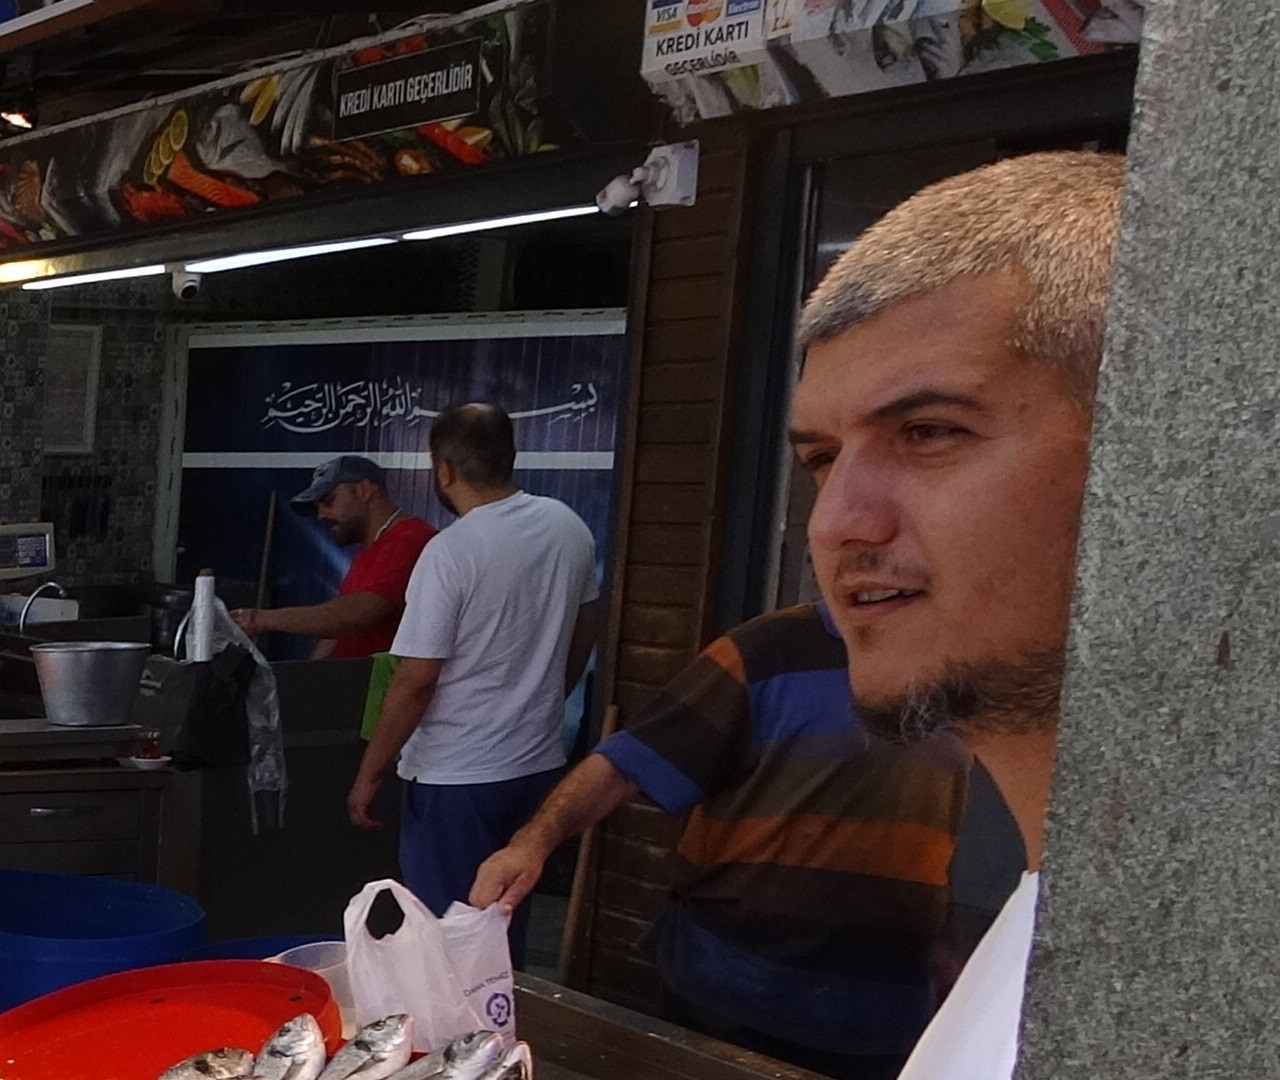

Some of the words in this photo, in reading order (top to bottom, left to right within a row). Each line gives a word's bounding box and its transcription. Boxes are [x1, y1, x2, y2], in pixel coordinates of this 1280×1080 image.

[656, 7, 679, 23] VISA
[656, 28, 701, 57] KREDİ
[703, 20, 749, 47] KARTI
[340, 83, 372, 117] KREDİ
[372, 79, 405, 110] KARTI
[406, 61, 474, 104] GEÇERLİDİR
